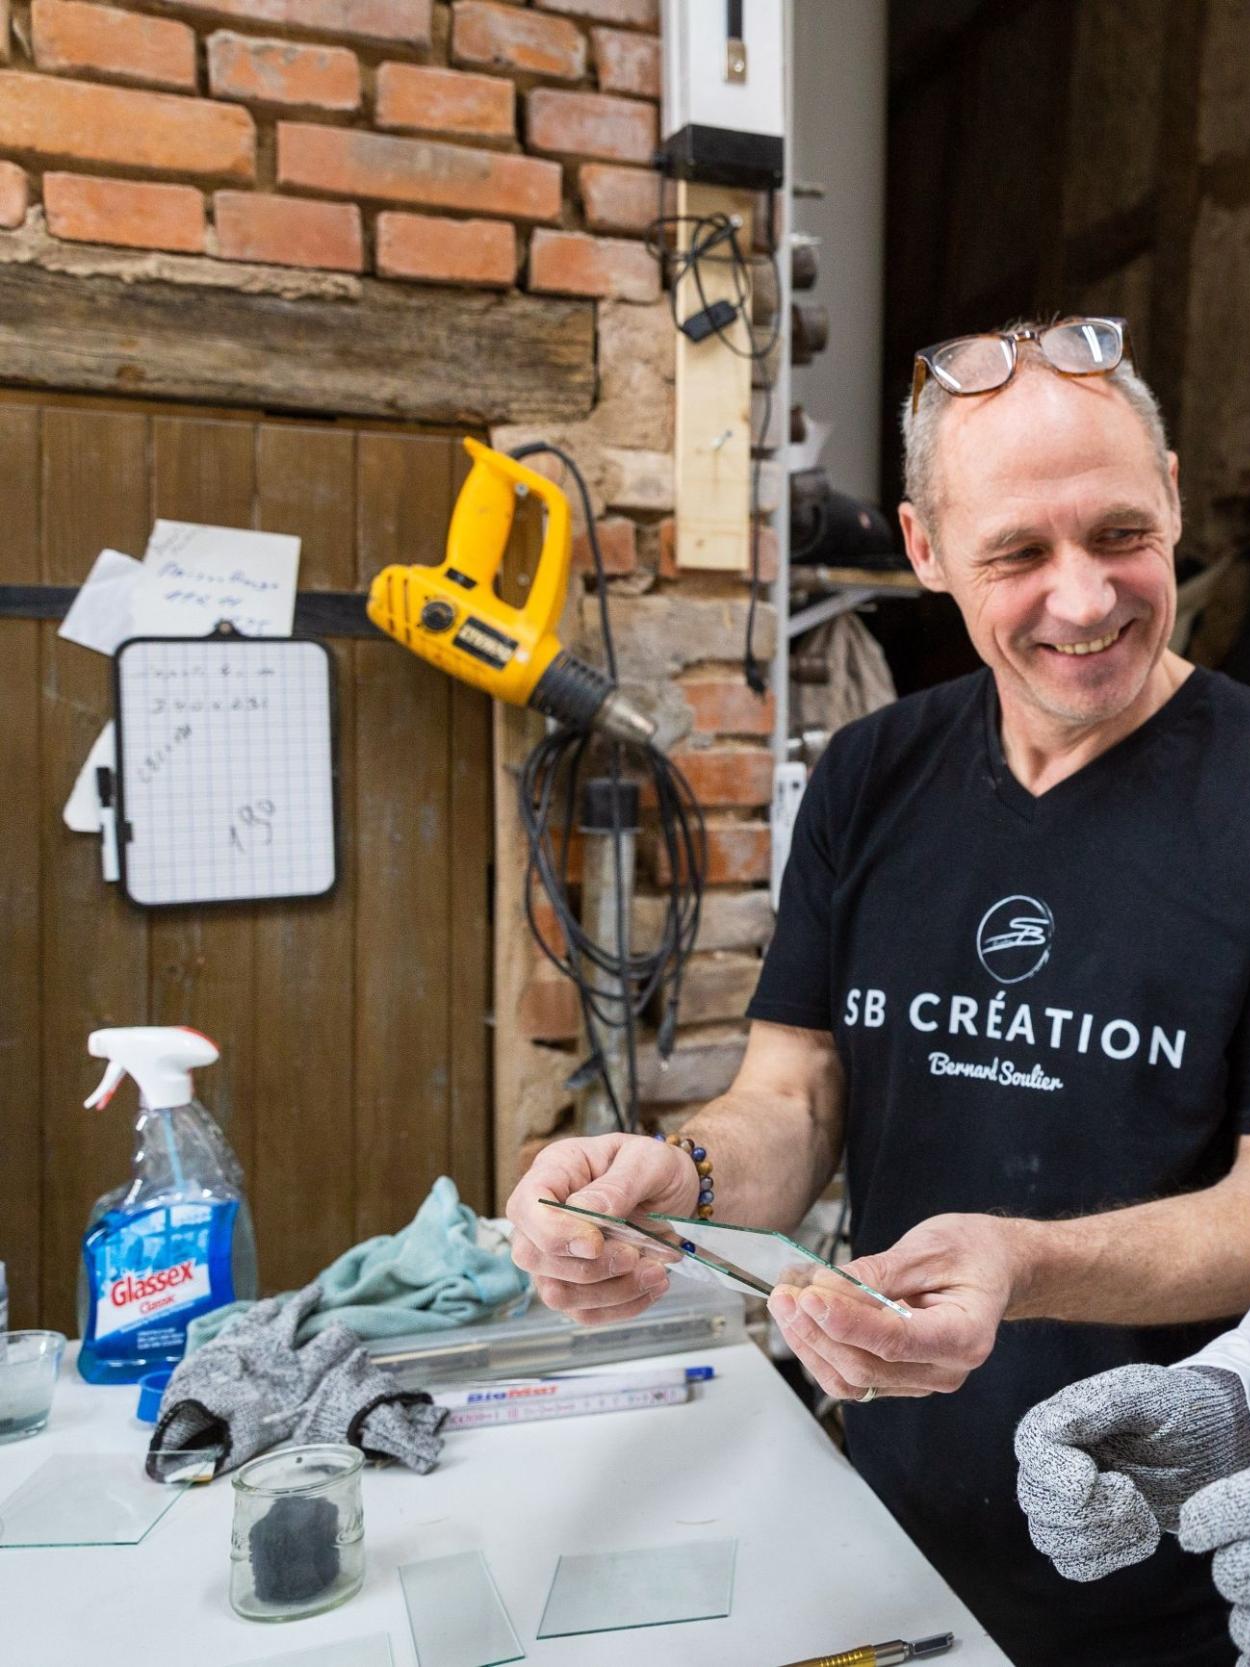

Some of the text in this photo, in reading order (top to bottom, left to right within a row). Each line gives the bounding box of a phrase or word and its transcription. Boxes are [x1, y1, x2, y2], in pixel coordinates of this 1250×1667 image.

[844, 988, 1187, 1069] SB CRÉATION
[928, 1051, 1063, 1092] Bernard Soulier
[110, 1261, 194, 1307] Glassex
